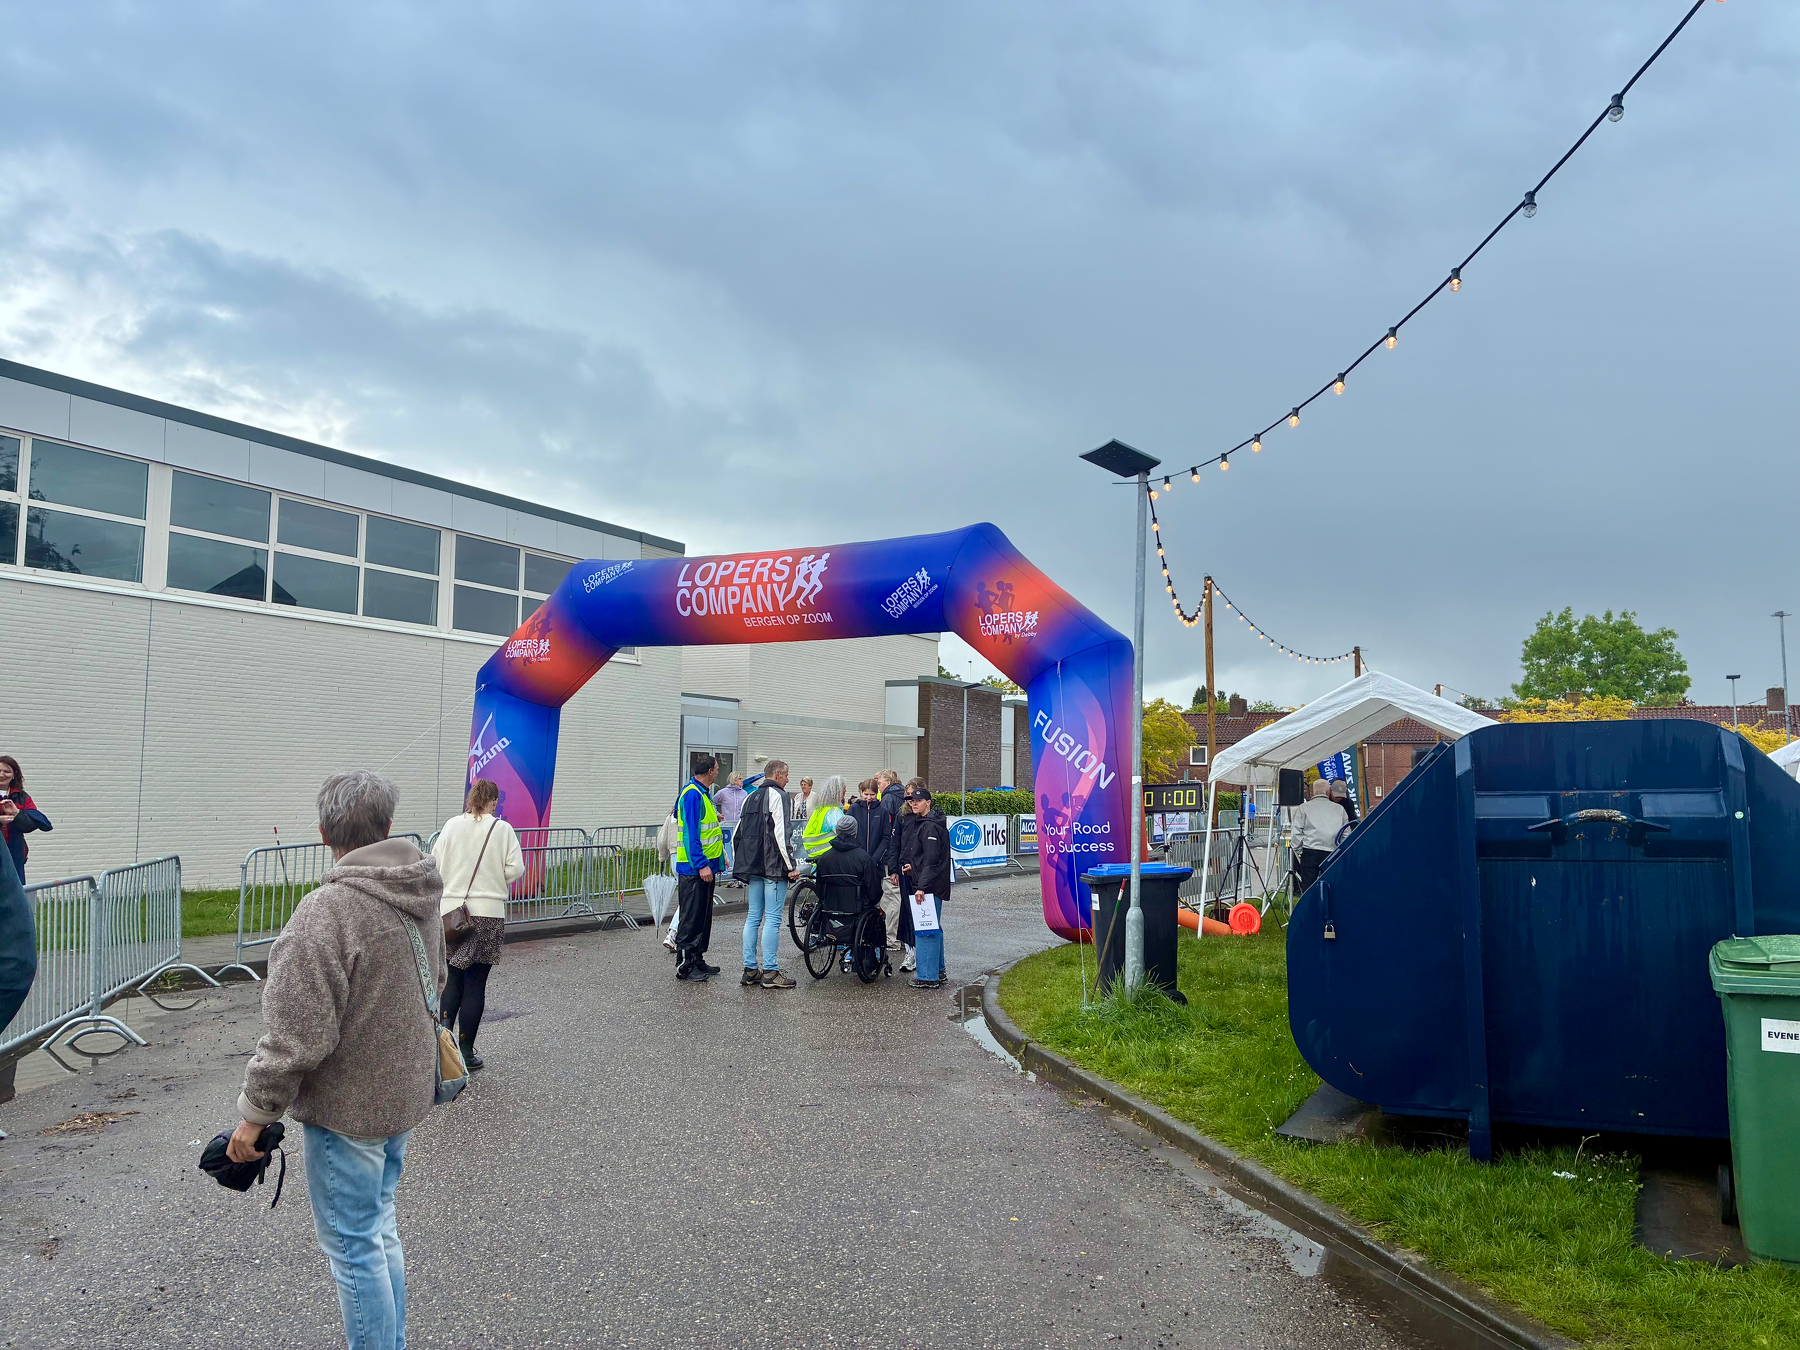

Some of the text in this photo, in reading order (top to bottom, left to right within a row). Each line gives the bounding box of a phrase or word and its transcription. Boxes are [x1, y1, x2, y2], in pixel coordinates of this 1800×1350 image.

[582, 563, 621, 587] LOPERS
[585, 567, 622, 594] COMPANY
[677, 556, 793, 587] LOPERS
[675, 582, 788, 617] COMPANY
[880, 576, 918, 613] LOPERS
[889, 584, 923, 619] COMPANY
[743, 612, 834, 628] BERGEN OP ZOOM
[978, 611, 1024, 627] LOPERS
[981, 622, 1023, 637] COMPANY
[505, 648, 539, 659] COMPANY
[507, 639, 539, 650] LOPERS
[1033, 709, 1116, 790] FUSION
[955, 823, 1006, 847] Ford Iriks
[1044, 821, 1111, 836] Your Road
[1045, 840, 1115, 854] to Success
[1767, 1030, 1800, 1041] EVENE
